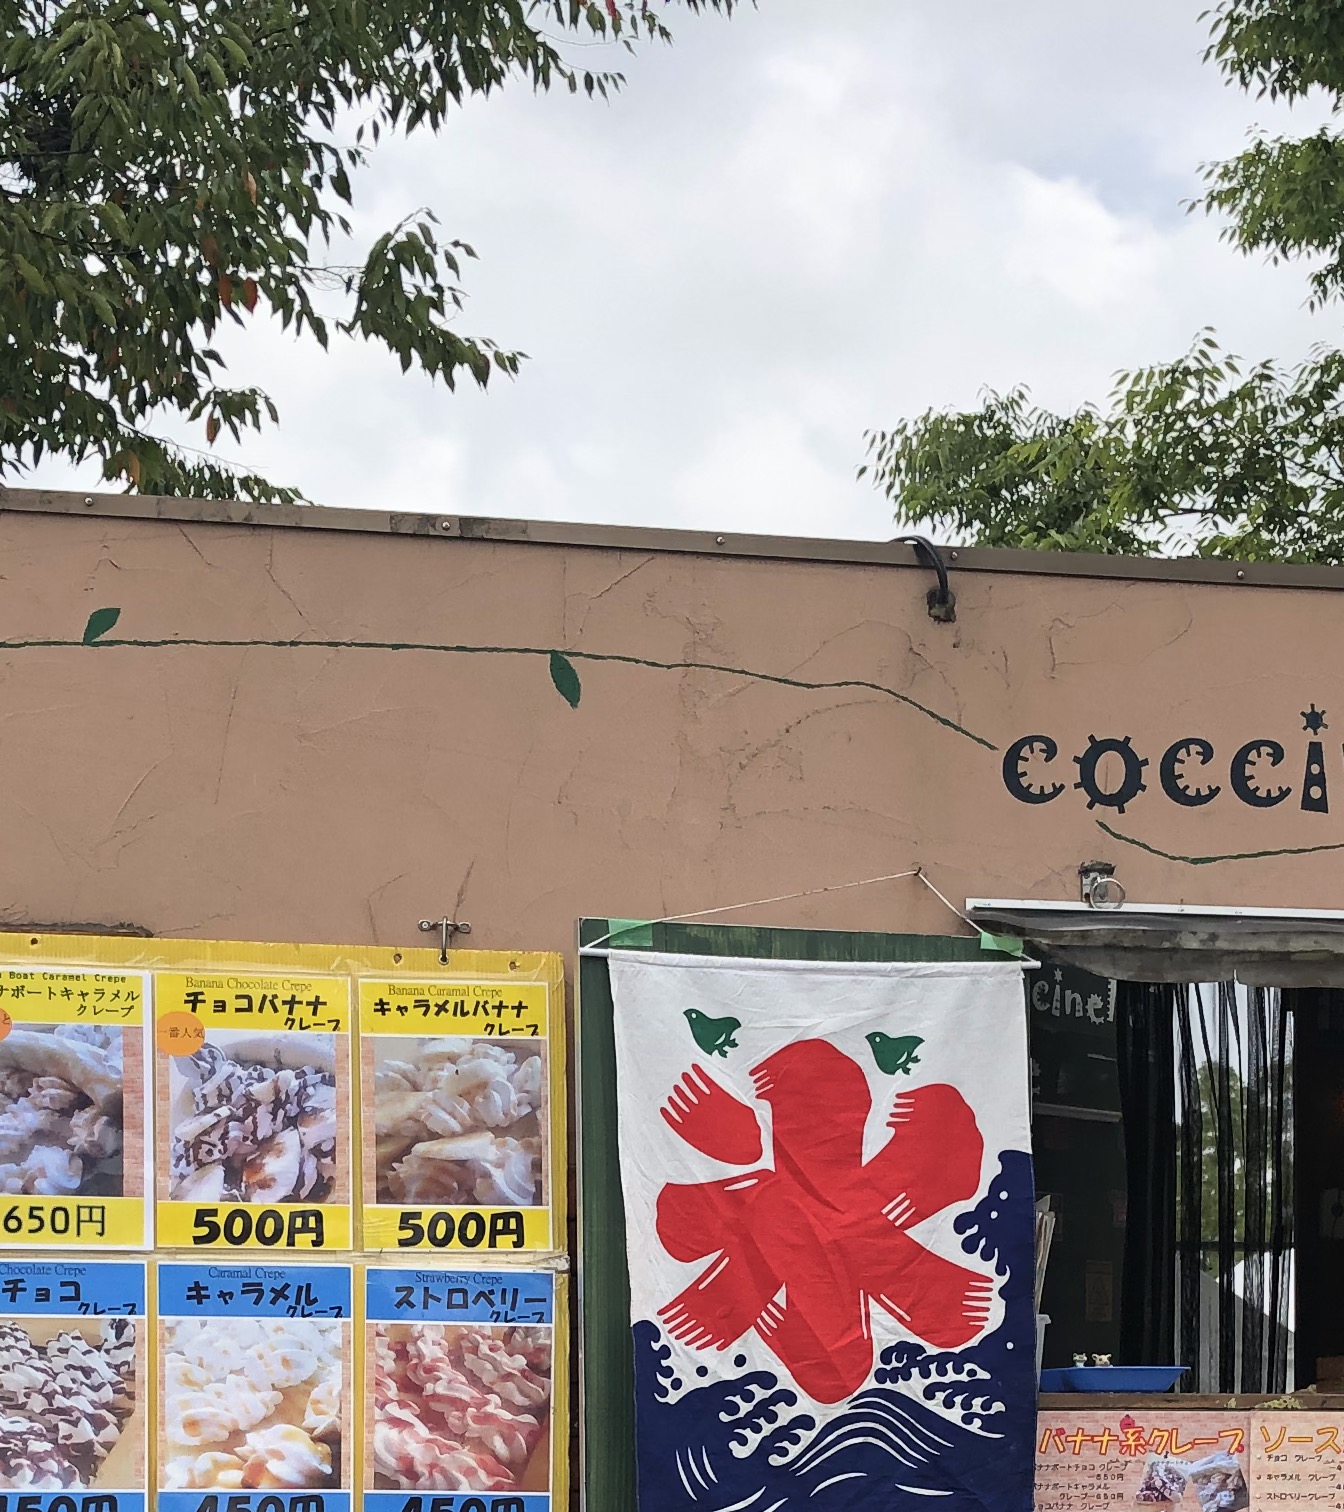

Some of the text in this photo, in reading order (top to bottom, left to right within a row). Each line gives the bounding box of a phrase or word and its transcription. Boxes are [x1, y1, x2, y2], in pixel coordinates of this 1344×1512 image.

[9, 971, 35, 981] Boat
[42, 972, 87, 983] Caramel
[94, 974, 126, 984] Crepe
[185, 976, 312, 993] Banana Chocolate Crepe
[388, 984, 426, 997] Banana
[472, 986, 503, 999] Crepe
[76, 1004, 135, 1017] クレープ
[183, 991, 328, 1017] チョコバナナ
[373, 998, 529, 1019] キャラメルバナナ
[283, 1016, 341, 1032] クレープ
[483, 1022, 539, 1037] クレープ
[158, 1025, 205, 1040] 一番人気
[3, 1204, 106, 1236] 650円
[192, 1208, 325, 1247] 500円
[397, 1211, 524, 1247] 500円
[54, 1265, 87, 1278] Crepe
[255, 1268, 286, 1281] Crepe
[415, 1271, 503, 1286] Strawberry Crepe
[1, 1278, 81, 1303] チョコ
[186, 1281, 319, 1307] キャラメル
[394, 1286, 547, 1311] ストロベリー
[77, 1301, 137, 1316] クレープ
[286, 1304, 344, 1319] クレープ
[489, 1310, 545, 1324] クレープ
[1039, 1426, 1245, 1456] バナナ系クレープ
